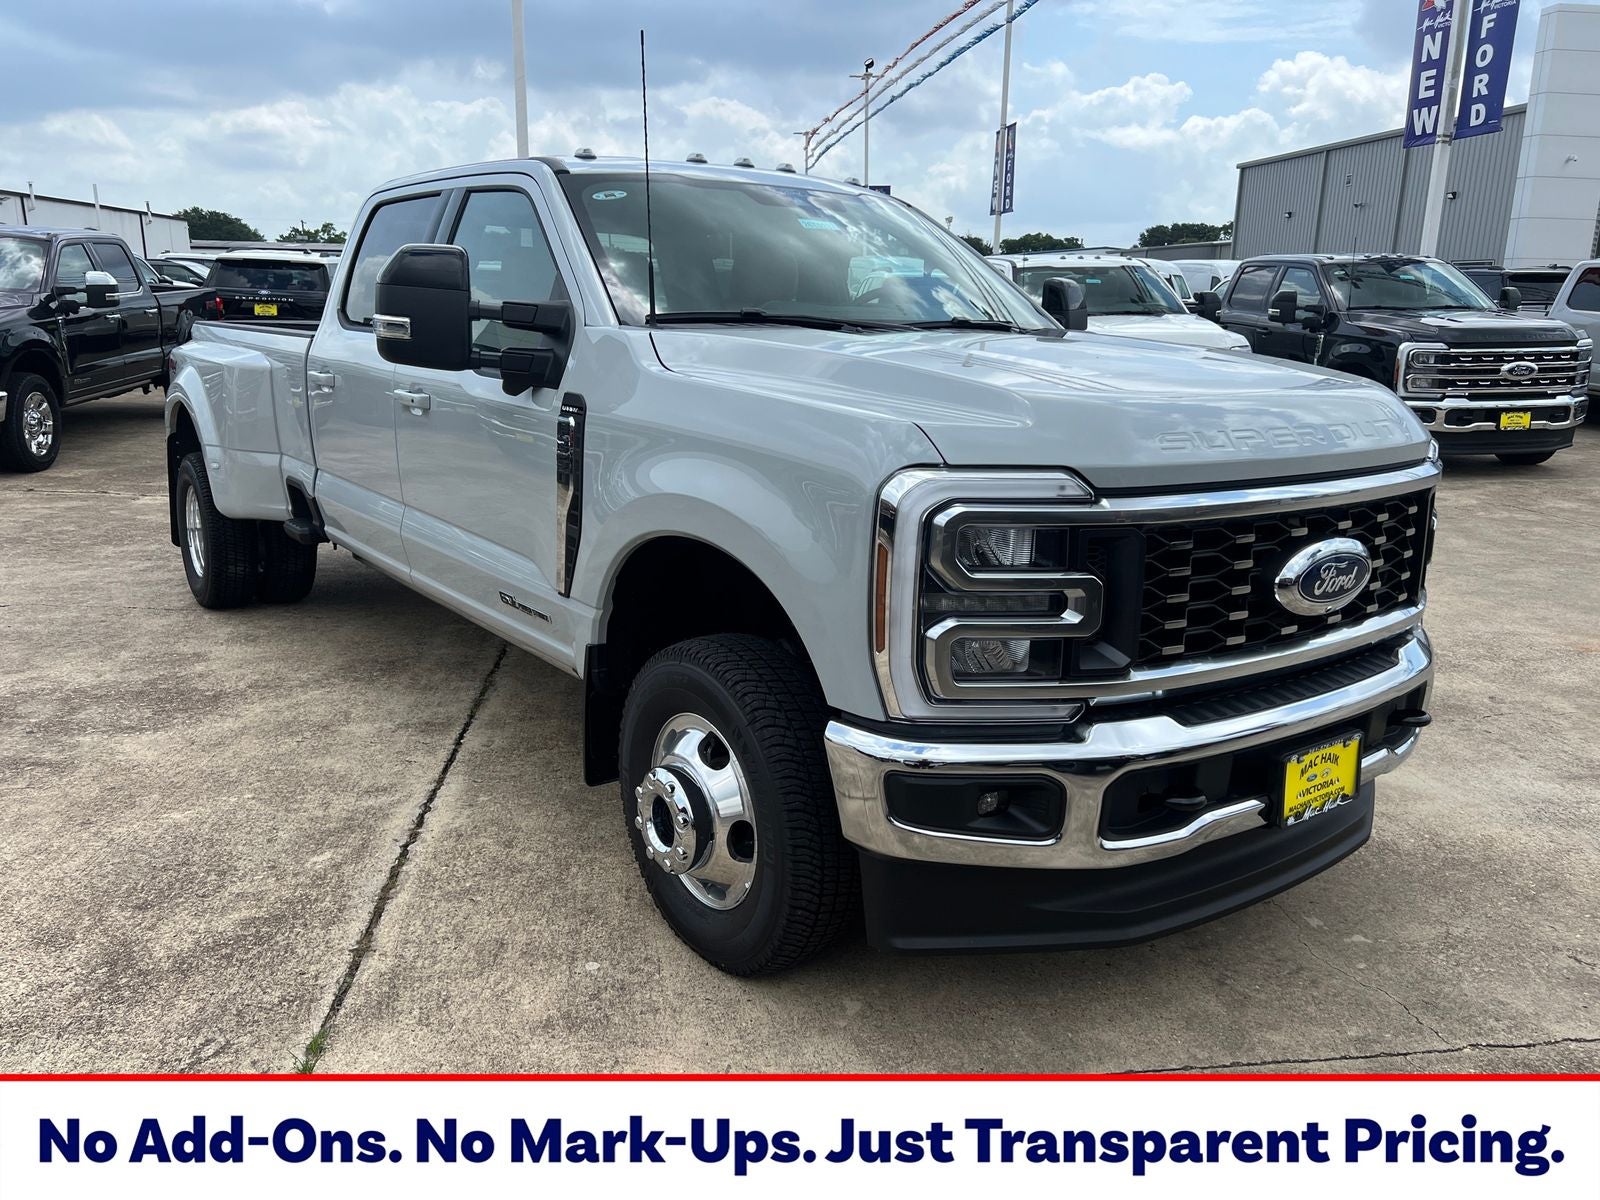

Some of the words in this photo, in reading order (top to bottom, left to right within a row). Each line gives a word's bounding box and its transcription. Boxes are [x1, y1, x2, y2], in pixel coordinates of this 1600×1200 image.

[1413, 31, 1442, 136] NEW
[1469, 13, 1497, 127] FORD
[1156, 423, 1326, 450] SUPER
[1314, 562, 1359, 596] Ford
[1299, 755, 1320, 780] MAC
[1320, 752, 1340, 766] HAIK
[1289, 786, 1346, 813] MACHAIKVICTORIA.COM
[1301, 778, 1336, 798] VICTORIA
